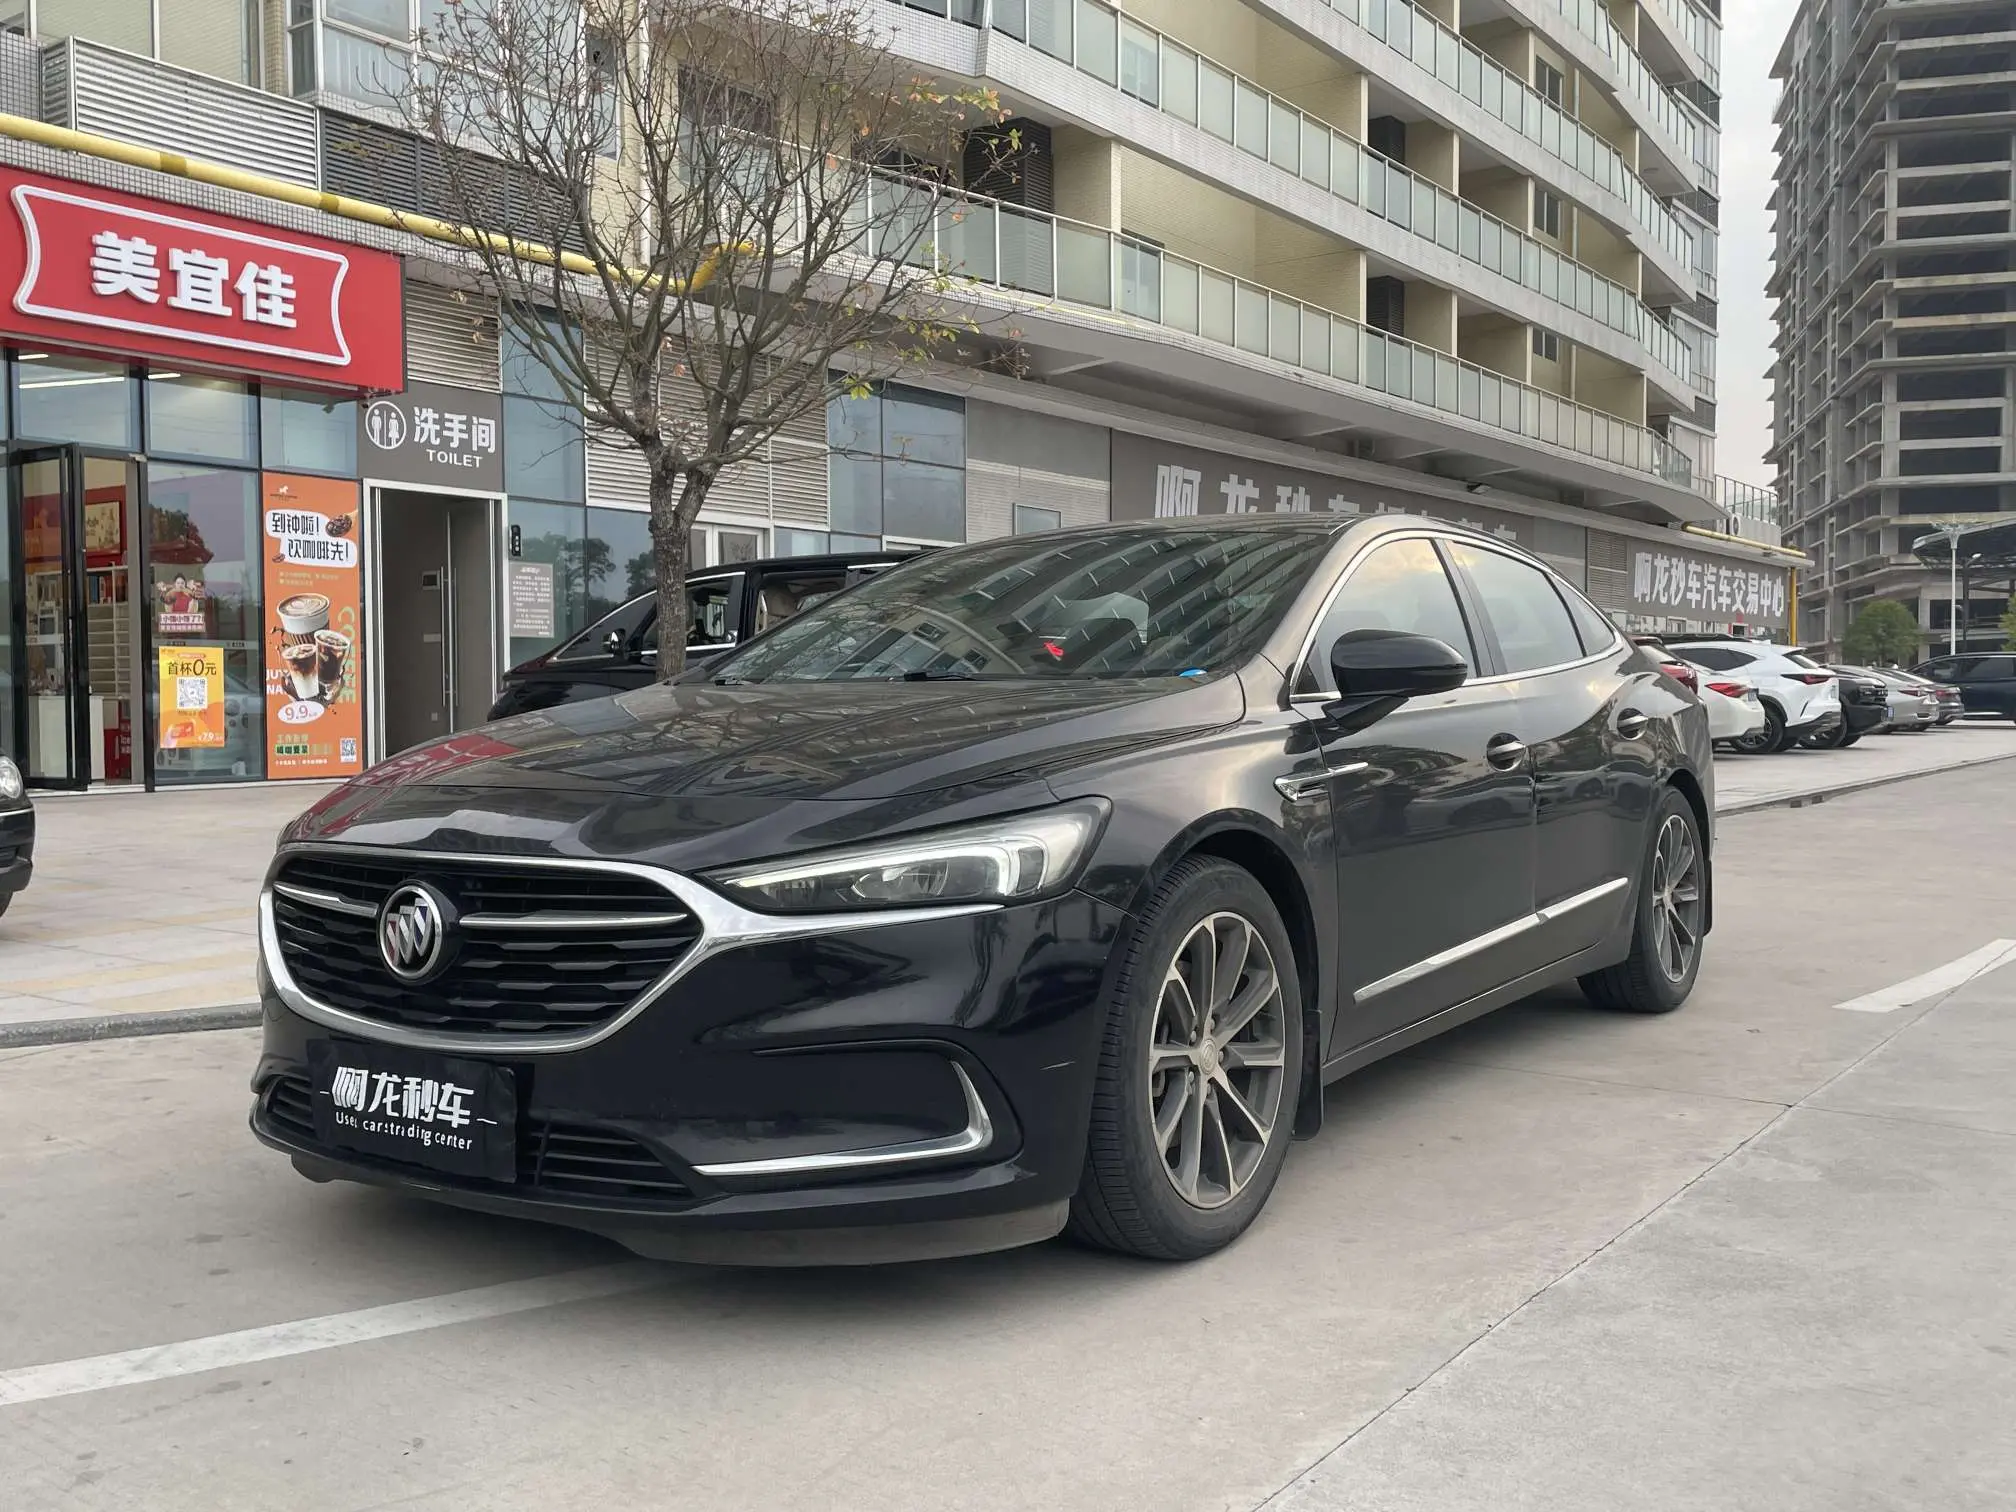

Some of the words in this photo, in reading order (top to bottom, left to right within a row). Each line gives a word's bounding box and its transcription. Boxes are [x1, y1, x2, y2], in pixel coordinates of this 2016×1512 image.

[90, 231, 297, 328] 美宜佳
[413, 406, 496, 454] 洗手间
[426, 449, 483, 468] TOILET
[1634, 552, 1785, 618] 啊龙秒车汽车交易中心
[168, 659, 217, 676] 首杯0元
[332, 1066, 474, 1128] 啊龙秒车
